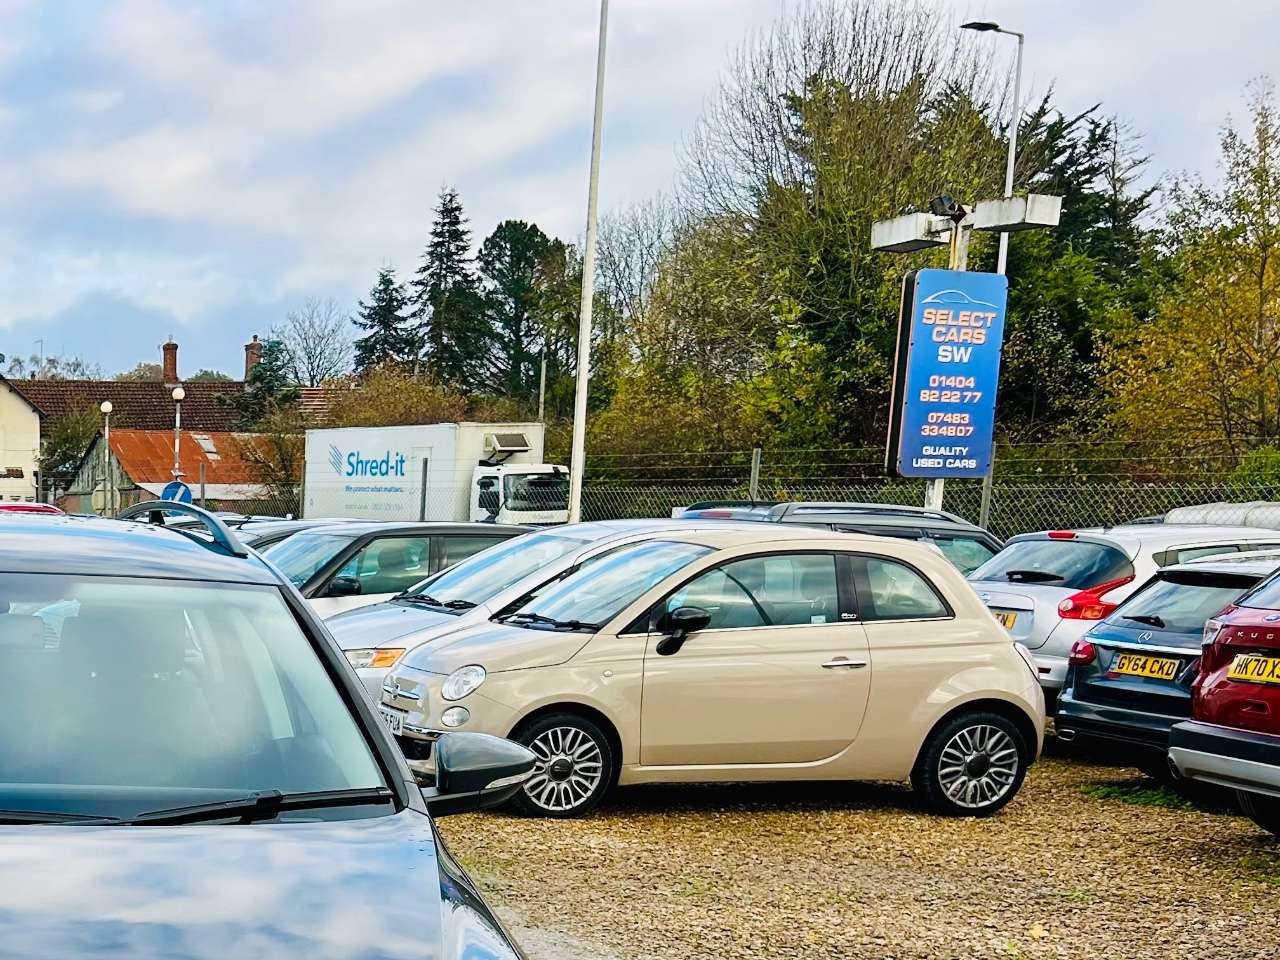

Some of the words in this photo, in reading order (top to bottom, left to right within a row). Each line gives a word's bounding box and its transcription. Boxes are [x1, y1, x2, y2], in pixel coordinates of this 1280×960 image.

[922, 308, 996, 328] SELECT
[932, 326, 986, 345] CARS
[937, 345, 972, 363] SW
[929, 375, 975, 389] 01404
[928, 412, 969, 424] 07483
[921, 424, 974, 437] 334807
[922, 446, 968, 456] QUALITY
[346, 450, 405, 477] Shred-it
[912, 458, 943, 468] USED
[945, 459, 977, 469] CARS
[1117, 655, 1148, 673] GY64
[1149, 659, 1176, 677] CKD
[1233, 657, 1268, 677] HK70
